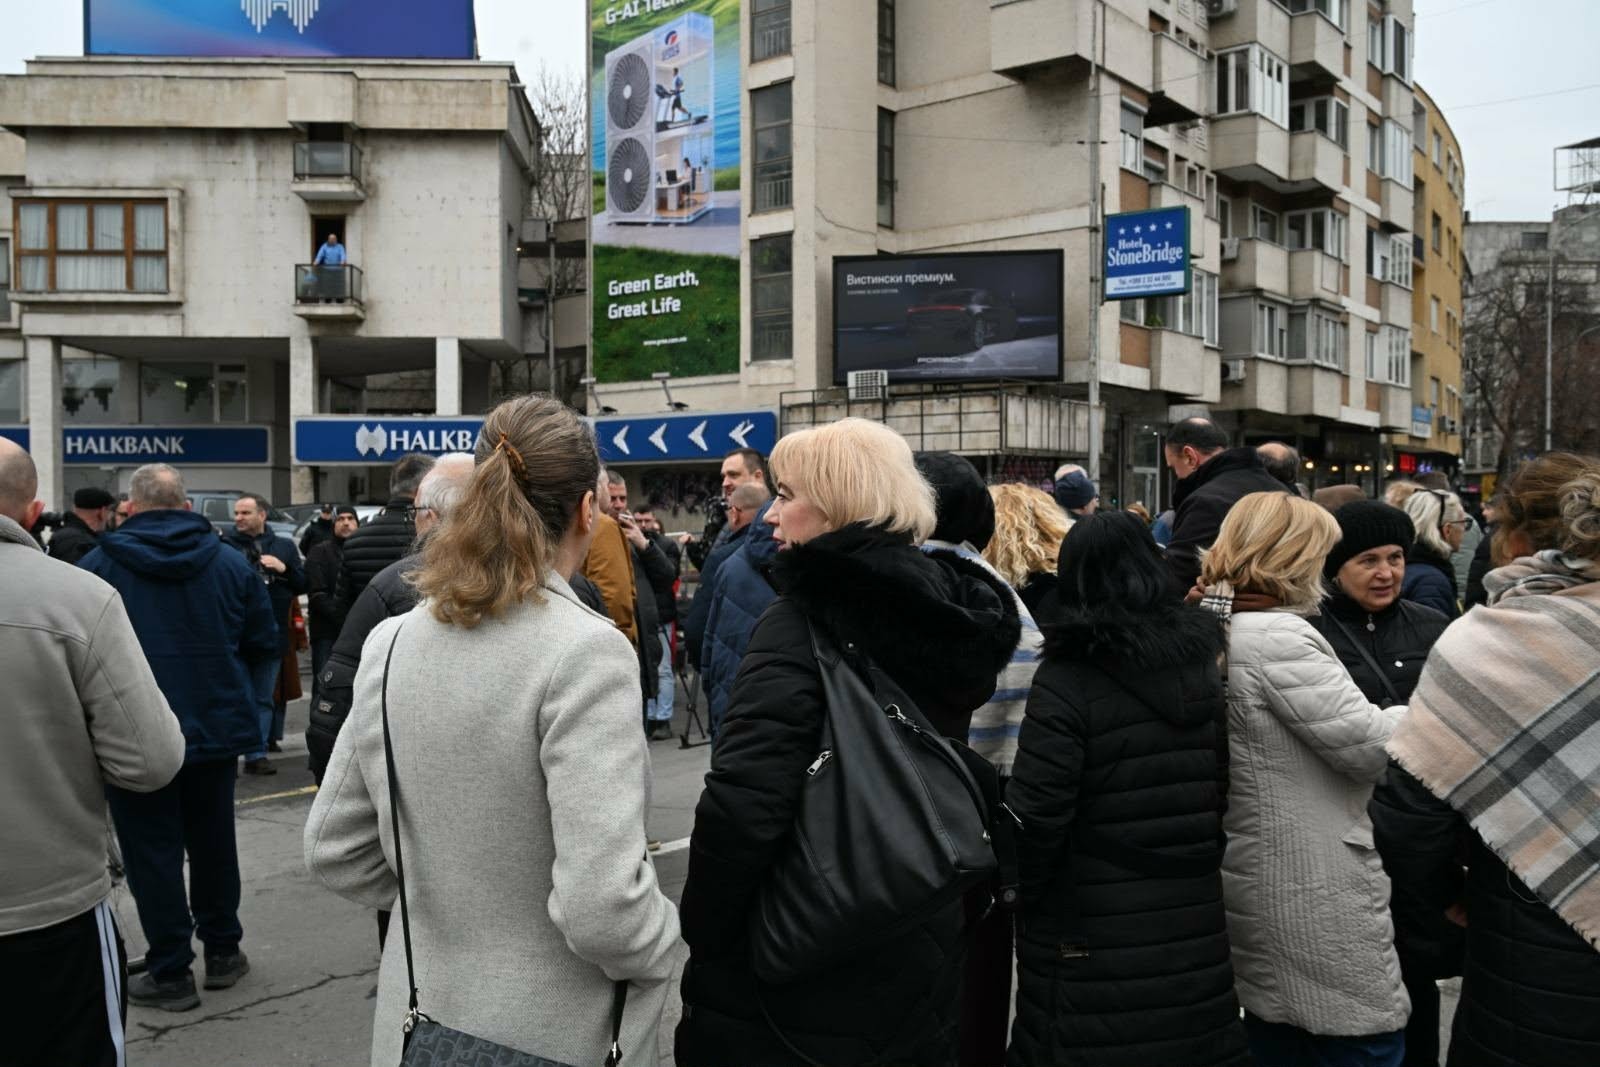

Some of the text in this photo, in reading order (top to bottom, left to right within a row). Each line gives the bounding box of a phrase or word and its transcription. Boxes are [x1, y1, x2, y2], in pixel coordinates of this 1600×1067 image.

[605, 0, 640, 25] G-AI
[1107, 241, 1183, 267] StoneBridge
[1118, 237, 1143, 250] Hotel
[608, 269, 700, 296] Green Earth,
[847, 272, 957, 286] Вистински премиум.
[608, 296, 681, 320] Great Life
[66, 436, 184, 454] HALKBANK
